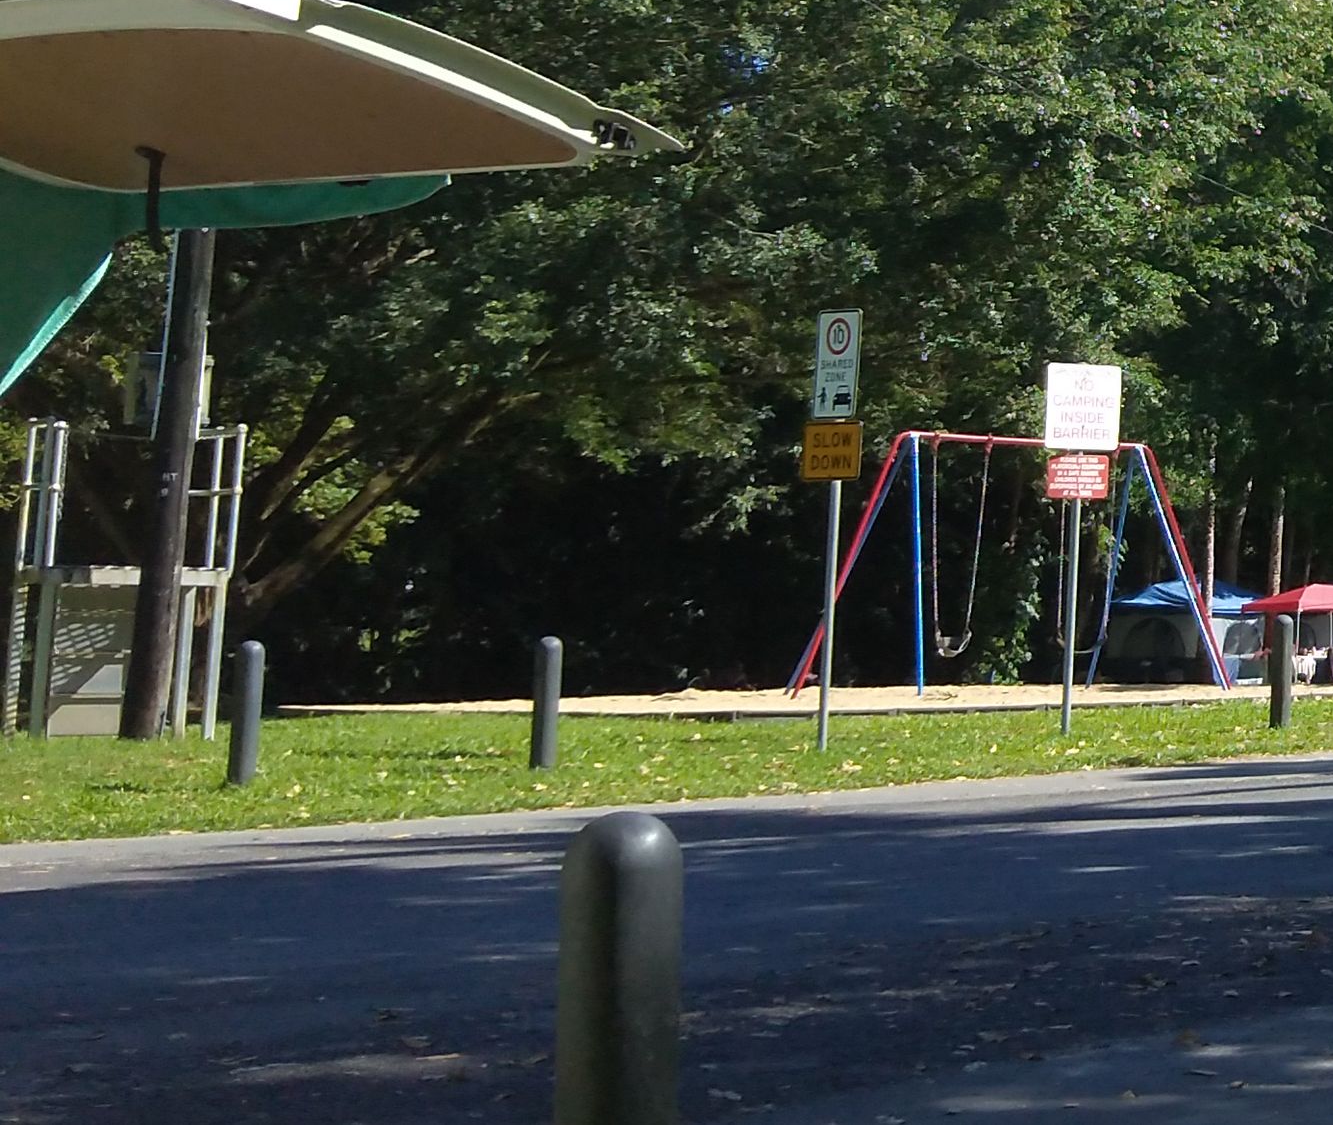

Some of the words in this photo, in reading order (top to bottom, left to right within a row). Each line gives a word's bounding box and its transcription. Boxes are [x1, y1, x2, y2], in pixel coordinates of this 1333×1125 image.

[833, 328, 845, 345] 10
[821, 359, 853, 370] SHARED
[825, 372, 847, 382] ZONE
[1074, 379, 1094, 391] NO
[1053, 394, 1115, 408] CAMPING
[1061, 411, 1104, 424] INSIDE
[813, 432, 853, 448] SLOW
[1053, 427, 1110, 440] BARRIER
[811, 455, 852, 470] DOWN
